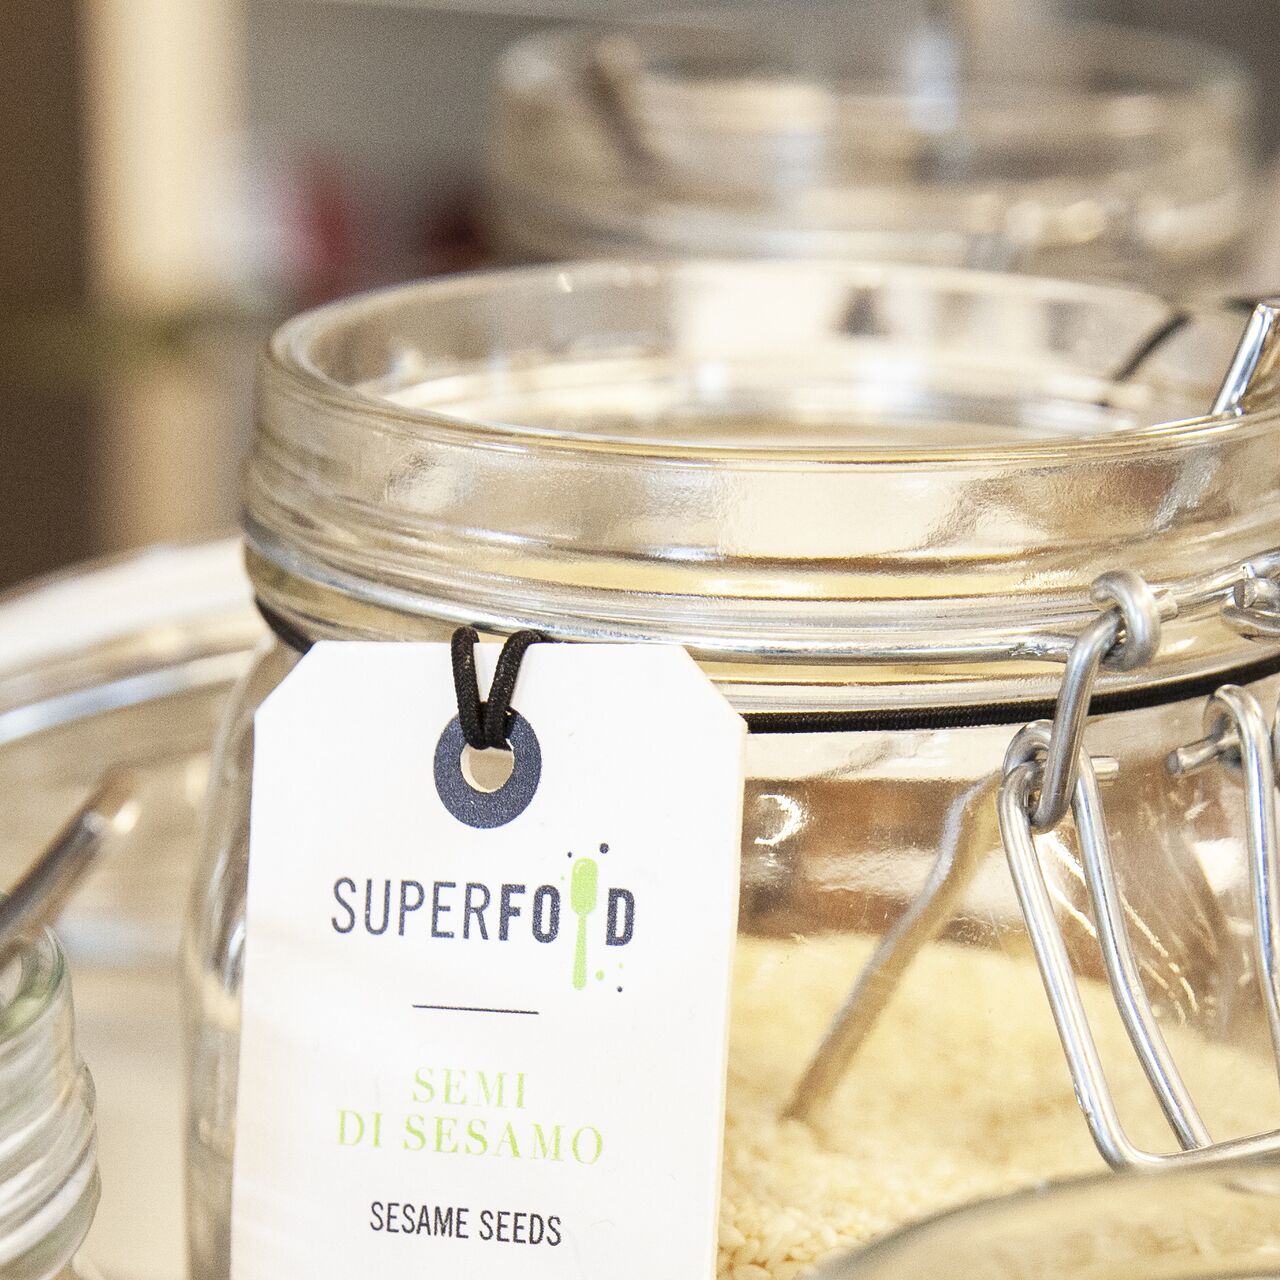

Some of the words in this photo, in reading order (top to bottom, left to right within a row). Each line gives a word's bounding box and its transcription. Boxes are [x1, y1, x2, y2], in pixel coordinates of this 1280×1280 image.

[411, 1066, 528, 1110] SEMI
[336, 1109, 384, 1149] DI
[403, 1114, 604, 1166] SESAMO
[369, 1200, 471, 1240] SESAME
[478, 1209, 562, 1248] SEEDS
